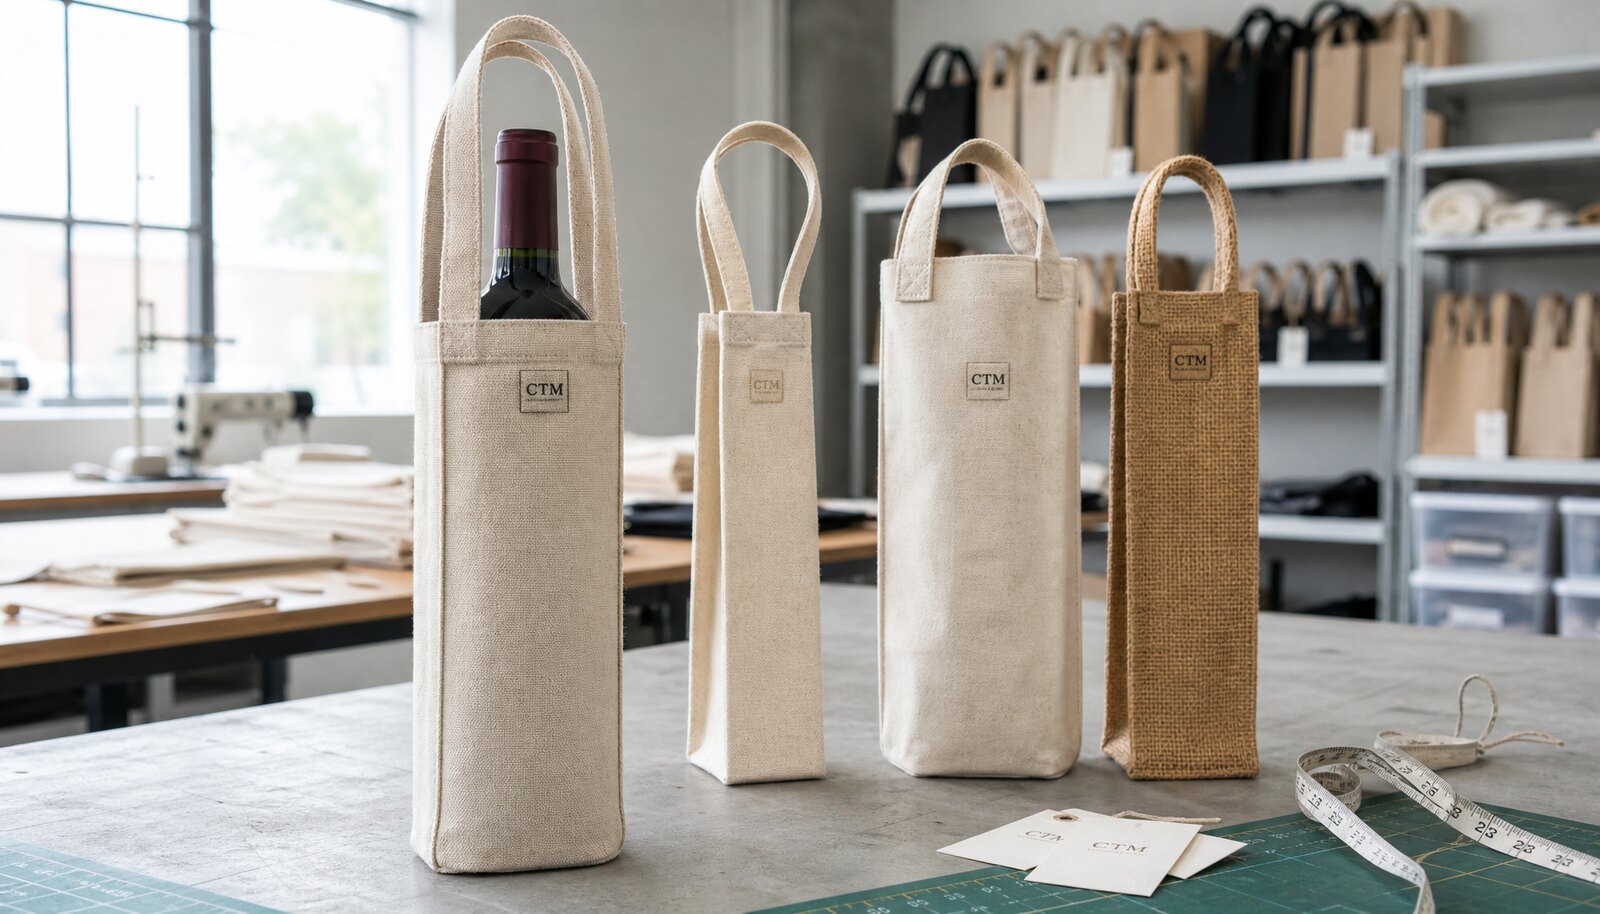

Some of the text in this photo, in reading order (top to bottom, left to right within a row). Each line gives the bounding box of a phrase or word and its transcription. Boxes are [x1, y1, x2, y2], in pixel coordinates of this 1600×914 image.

[1174, 354, 1207, 366] CTM
[753, 379, 780, 390] CTM
[971, 373, 1006, 385] CTM
[526, 382, 564, 396] CTM
[1474, 821, 1498, 839] 23
[1092, 841, 1149, 853] CTM
[1512, 839, 1536, 854] 23
[1551, 854, 1575, 867] 23
